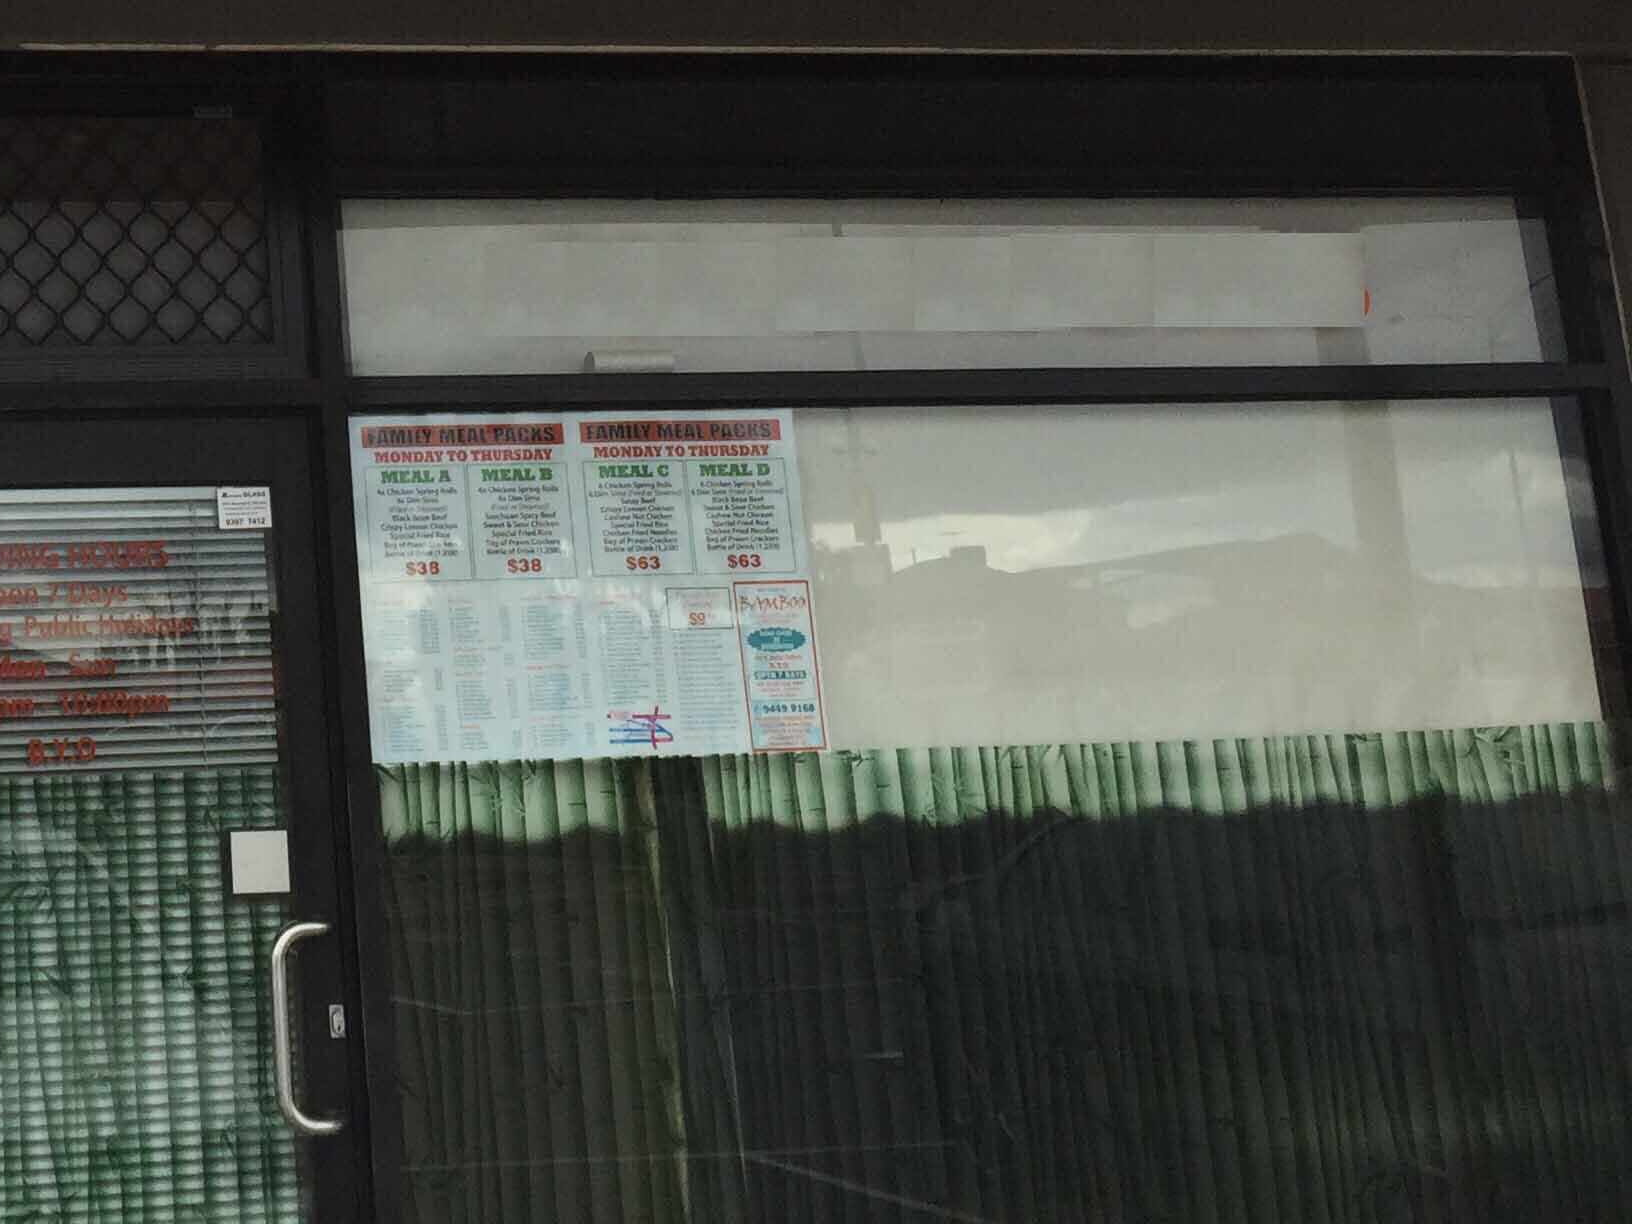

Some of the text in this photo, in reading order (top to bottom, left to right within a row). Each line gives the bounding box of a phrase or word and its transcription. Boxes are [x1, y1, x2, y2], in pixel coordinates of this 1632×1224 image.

[439, 427, 485, 443] MEAL
[495, 426, 555, 442] PACKS
[586, 423, 771, 440] FAMILY MEAL PACKS
[374, 448, 552, 463] MONDAY TO THURSDAY
[593, 444, 769, 458] MONDAY TO THURSDAY
[381, 470, 451, 484] MEAL A
[480, 467, 553, 481] MEAL B
[599, 464, 670, 478] MEAL C
[699, 463, 770, 477] MEAL D
[68, 540, 169, 569] HOURS
[727, 554, 762, 568] $63
[406, 561, 440, 575] $38
[507, 558, 542, 573] $38
[626, 556, 661, 570] $63
[48, 582, 60, 604] 7
[69, 581, 129, 608] Days
[24, 616, 93, 638] Public
[69, 652, 116, 678] Sun
